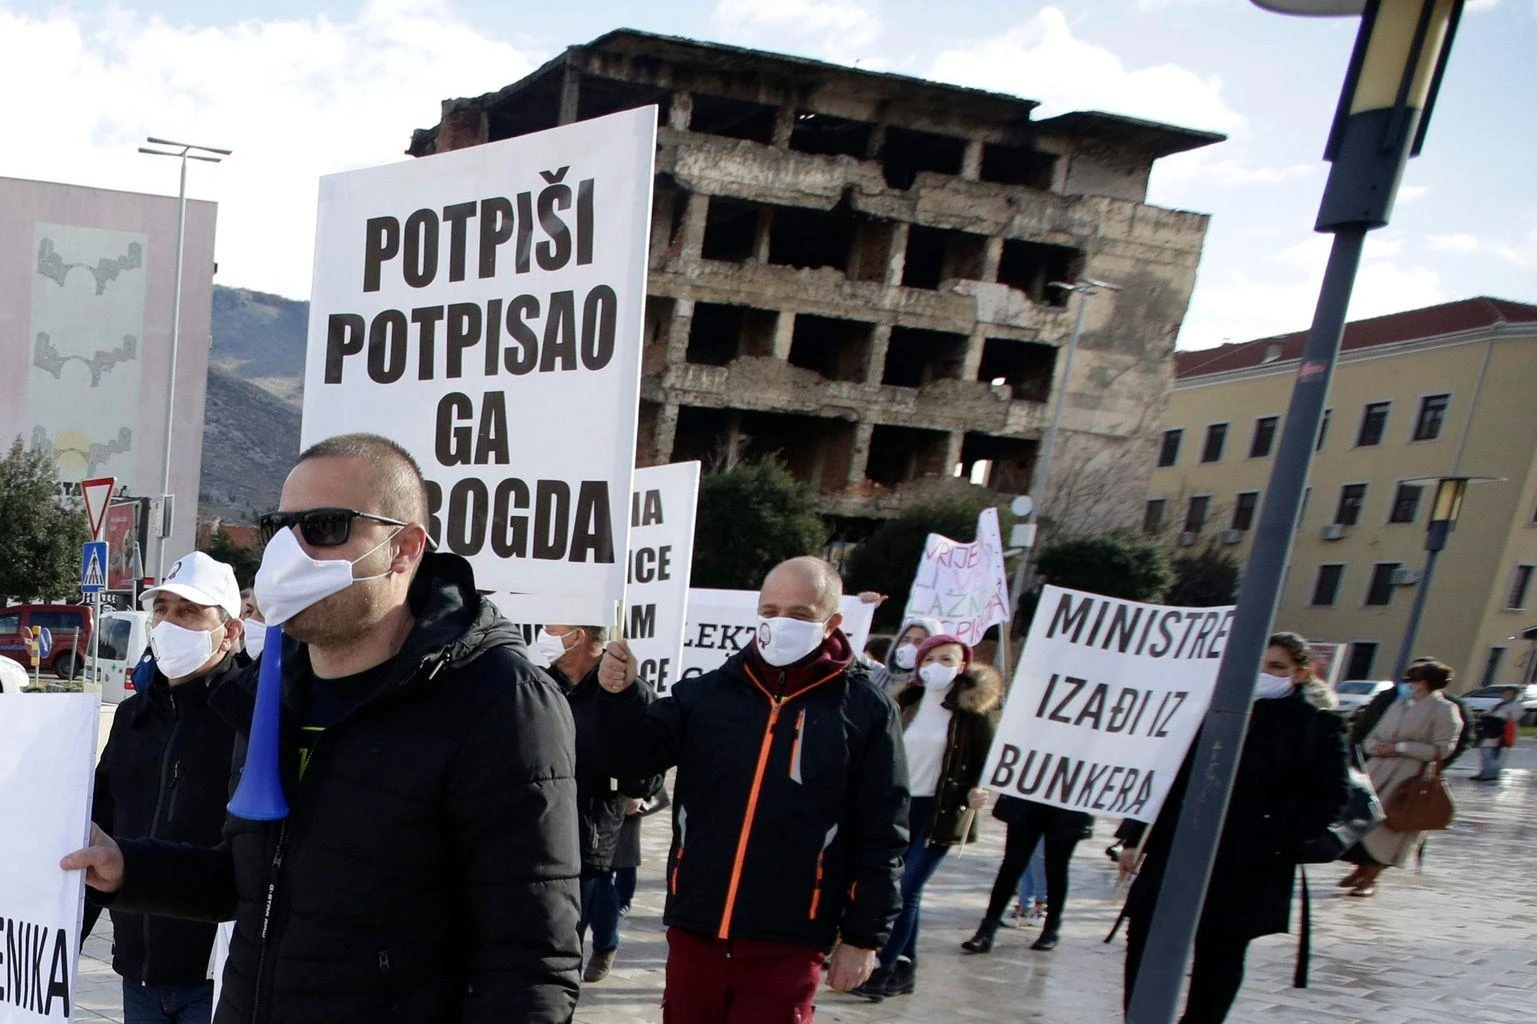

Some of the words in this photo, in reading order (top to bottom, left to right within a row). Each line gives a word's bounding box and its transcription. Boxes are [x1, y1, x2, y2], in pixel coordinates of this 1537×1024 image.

[364, 165, 595, 293] POTPIŠI
[324, 284, 618, 385] POTPISAO
[434, 390, 510, 467] GA
[1046, 594, 1236, 659] MINISTRE
[1035, 674, 1153, 736] IZAĐI
[1146, 690, 1189, 738] IZ
[990, 743, 1156, 815] BUNKERA
